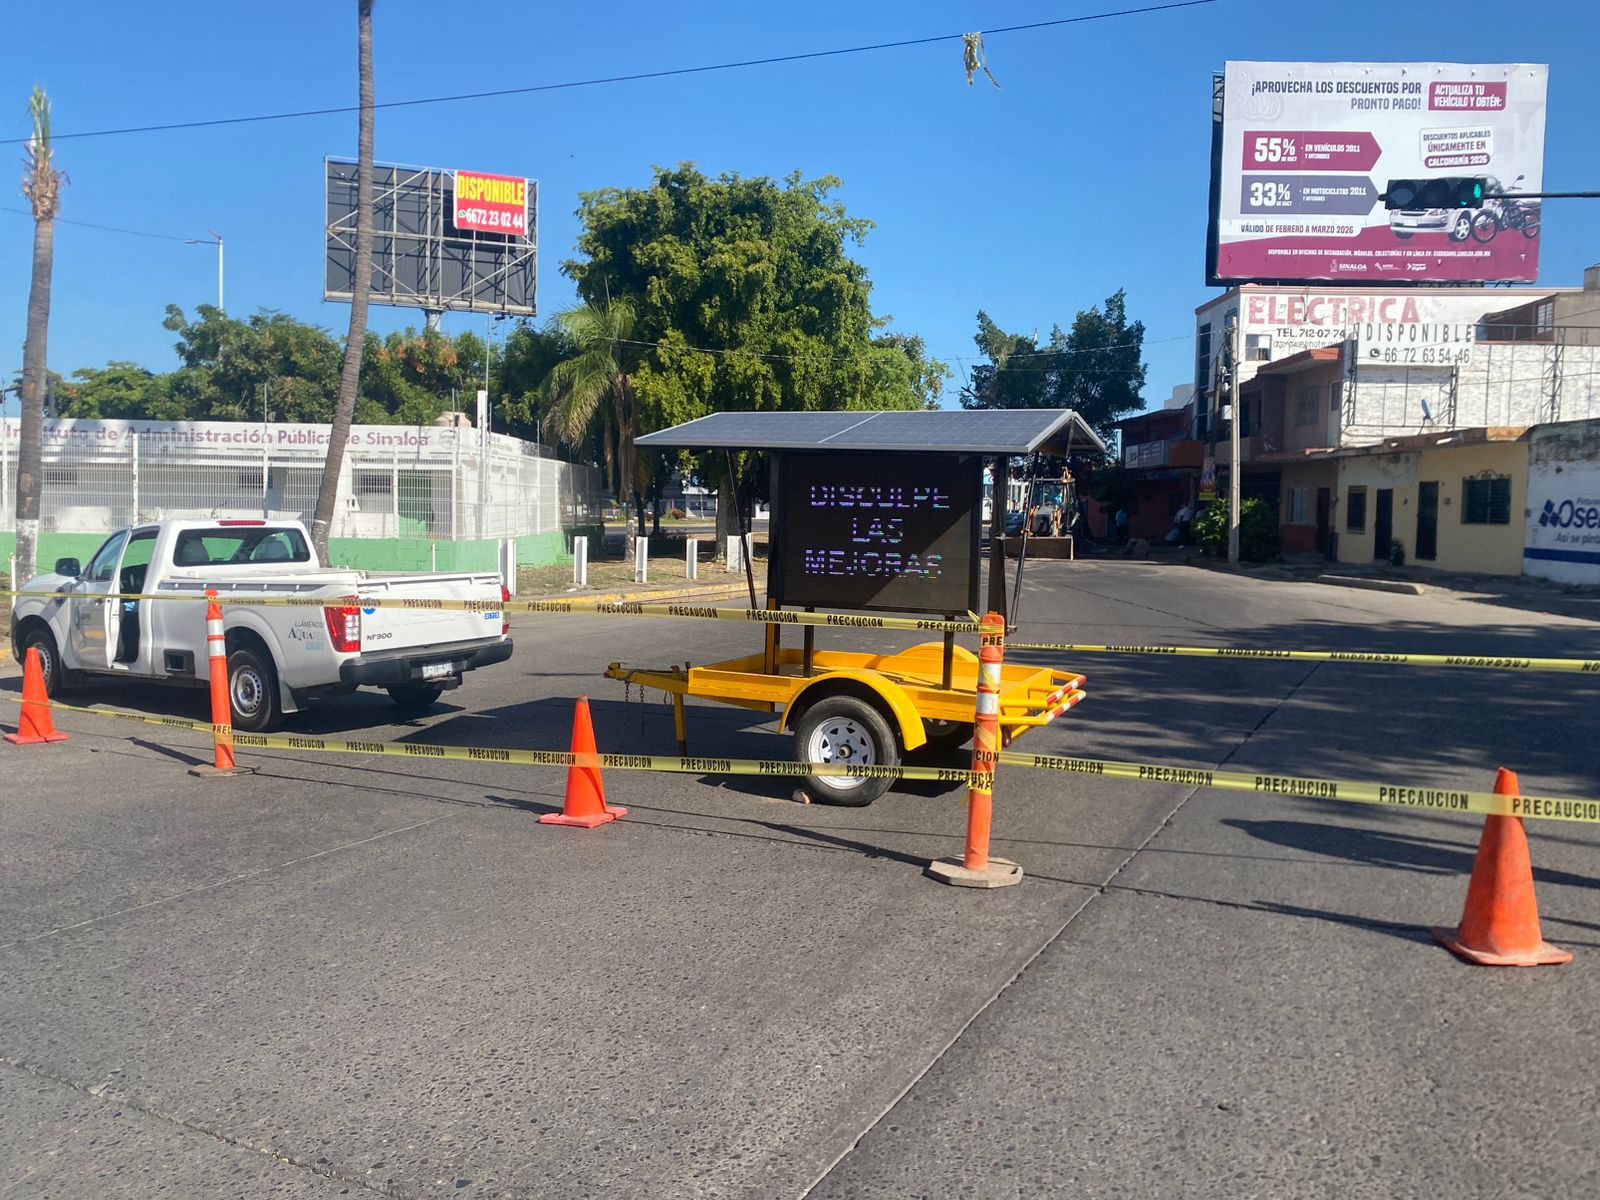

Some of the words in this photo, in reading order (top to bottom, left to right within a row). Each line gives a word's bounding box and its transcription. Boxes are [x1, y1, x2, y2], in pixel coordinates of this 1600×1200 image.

[1252, 81, 1312, 96] ¡APROVECHA
[1316, 82, 1334, 94] LOS
[1336, 82, 1399, 94] DESCUENTOS
[1402, 82, 1422, 94] POR
[1435, 84, 1474, 95] ACTUALIZA
[1475, 84, 1485, 95] TU
[1351, 98, 1390, 110] PRONTO
[1392, 98, 1422, 110] PAGO!
[1470, 96, 1475, 106] Y
[1423, 132, 1458, 141] DESCUENTOS
[1460, 130, 1491, 139] APLICABLES
[1254, 138, 1296, 162] 55%
[1304, 144, 1314, 152] EN
[1314, 143, 1345, 152] VEHÍCULOS
[1346, 144, 1360, 152] 2011
[1428, 142, 1474, 152] ÚNICAMENTE
[1476, 141, 1486, 150] EN
[458, 175, 524, 206] DISPONIBLE
[1250, 182, 1290, 206] 33%
[1350, 187, 1366, 195] 2011
[466, 208, 487, 225] 6672
[488, 210, 499, 226] 23
[501, 212, 512, 227] 02
[512, 214, 524, 228] 44
[1240, 222, 1264, 233] VÁLIDO
[1266, 224, 1274, 233] DE
[1275, 224, 1304, 233] FEBRERO
[1305, 225, 1310, 233] A
[1312, 225, 1334, 234] MARZO
[1336, 226, 1354, 234] 2026
[1248, 296, 1421, 326] ELECTRICA
[1366, 322, 1472, 342] DISPONIBLE
[1384, 348, 1398, 363] 66
[1404, 348, 1416, 363] 72
[1422, 348, 1436, 364] 63
[1438, 348, 1451, 364] 54
[96, 426, 118, 440] de
[366, 430, 429, 446] Sinaloa
[1558, 499, 1600, 528] Ose
[806, 550, 943, 579] MEJORAS
[464, 600, 505, 610] PRECAUCION
[527, 602, 572, 612] PRECAUCION
[597, 604, 644, 615] PRECAUCION
[669, 606, 718, 618] PRECAUCION
[746, 610, 799, 624] PRECAUCION
[827, 614, 884, 628] PRECAUCION
[917, 621, 979, 634] PRECAUCION
[233, 734, 268, 746] PRECAUCION
[288, 738, 326, 749] PRECAUCION
[346, 741, 385, 753] PRECAUCION
[404, 744, 445, 757] PRECAUCION
[468, 748, 510, 761] PRECAUCION
[534, 752, 576, 766] PRECAUCION
[604, 756, 652, 768] PRECAUCION
[680, 758, 732, 772] PRECAUCION
[759, 762, 813, 776] PRECAUCION
[846, 765, 905, 779] PRECAUCION
[1034, 756, 1104, 775] PRECAUCION
[1139, 766, 1213, 787] PRECAUCION
[1254, 776, 1338, 798] PRECAUCION
[1379, 787, 1469, 810] PRECAUCION
[1512, 798, 1600, 820] PRECAUCIO
